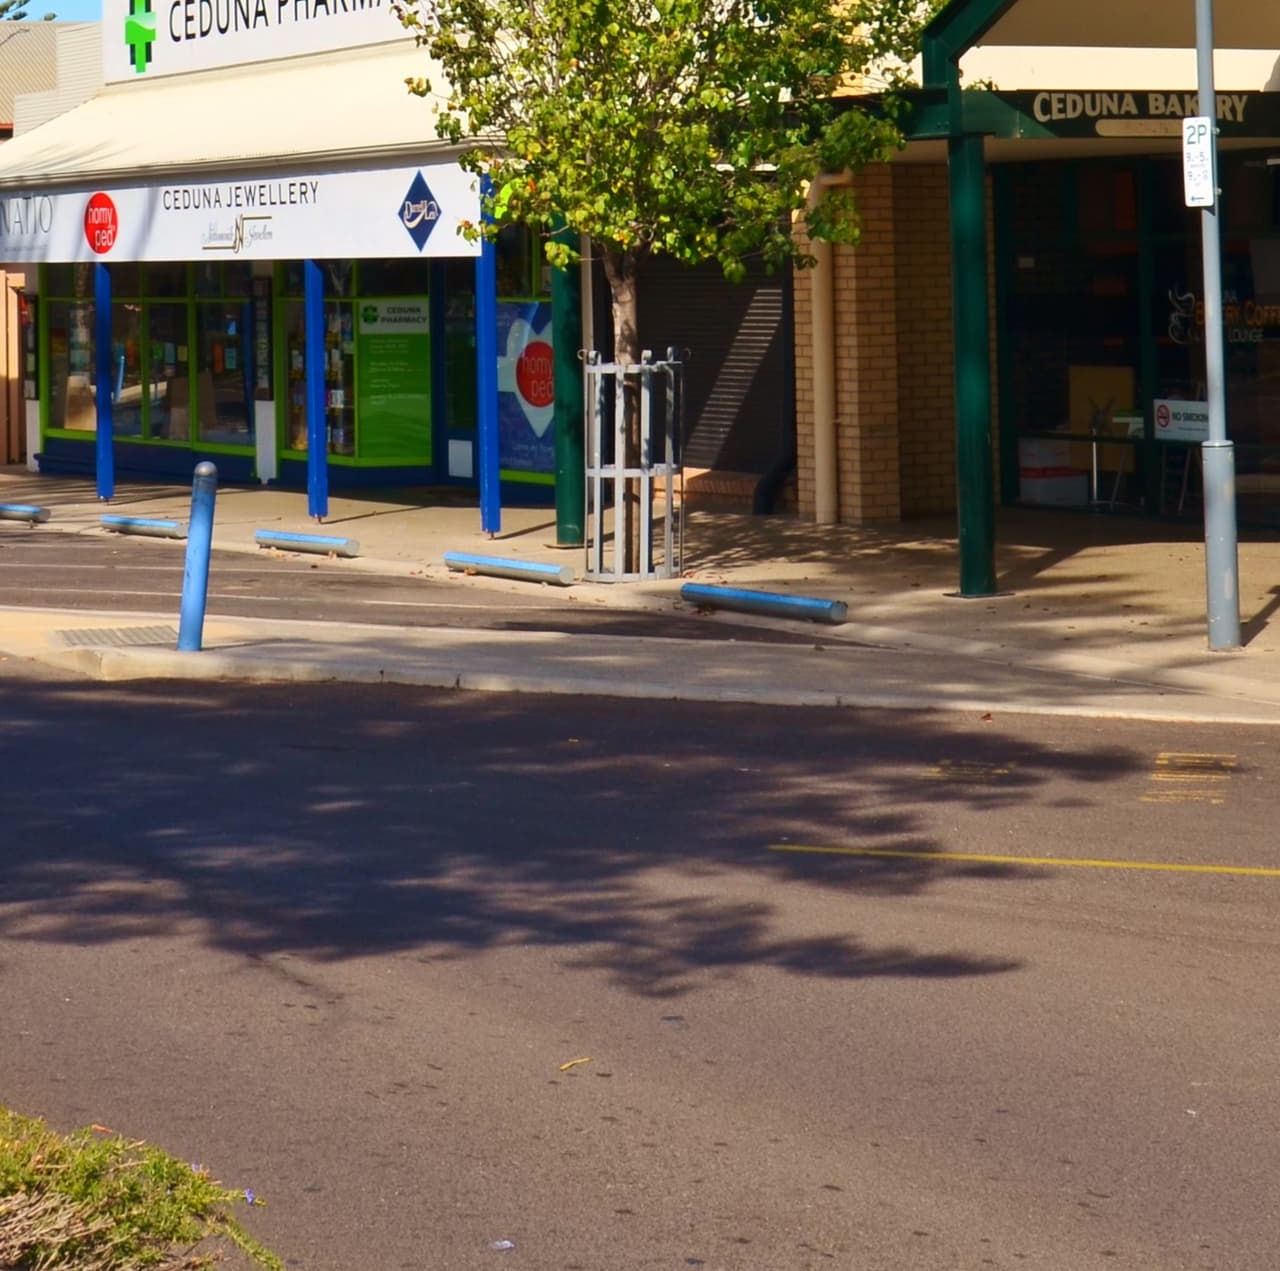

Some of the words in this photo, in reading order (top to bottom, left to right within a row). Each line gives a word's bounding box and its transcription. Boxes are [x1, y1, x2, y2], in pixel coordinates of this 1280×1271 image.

[1033, 92, 1139, 122] CEDUNA
[1148, 94, 1249, 122] BAKRY
[1186, 124, 1207, 145] 2P
[162, 187, 221, 210] CEDUNA
[226, 181, 319, 208] JEWELLERY
[0, 195, 54, 237] NATIO
[88, 205, 113, 231] homy
[95, 229, 115, 251] ped
[381, 316, 427, 324] PHARMACY
[386, 306, 422, 314] CEDUNA
[1172, 412, 1181, 421] NO
